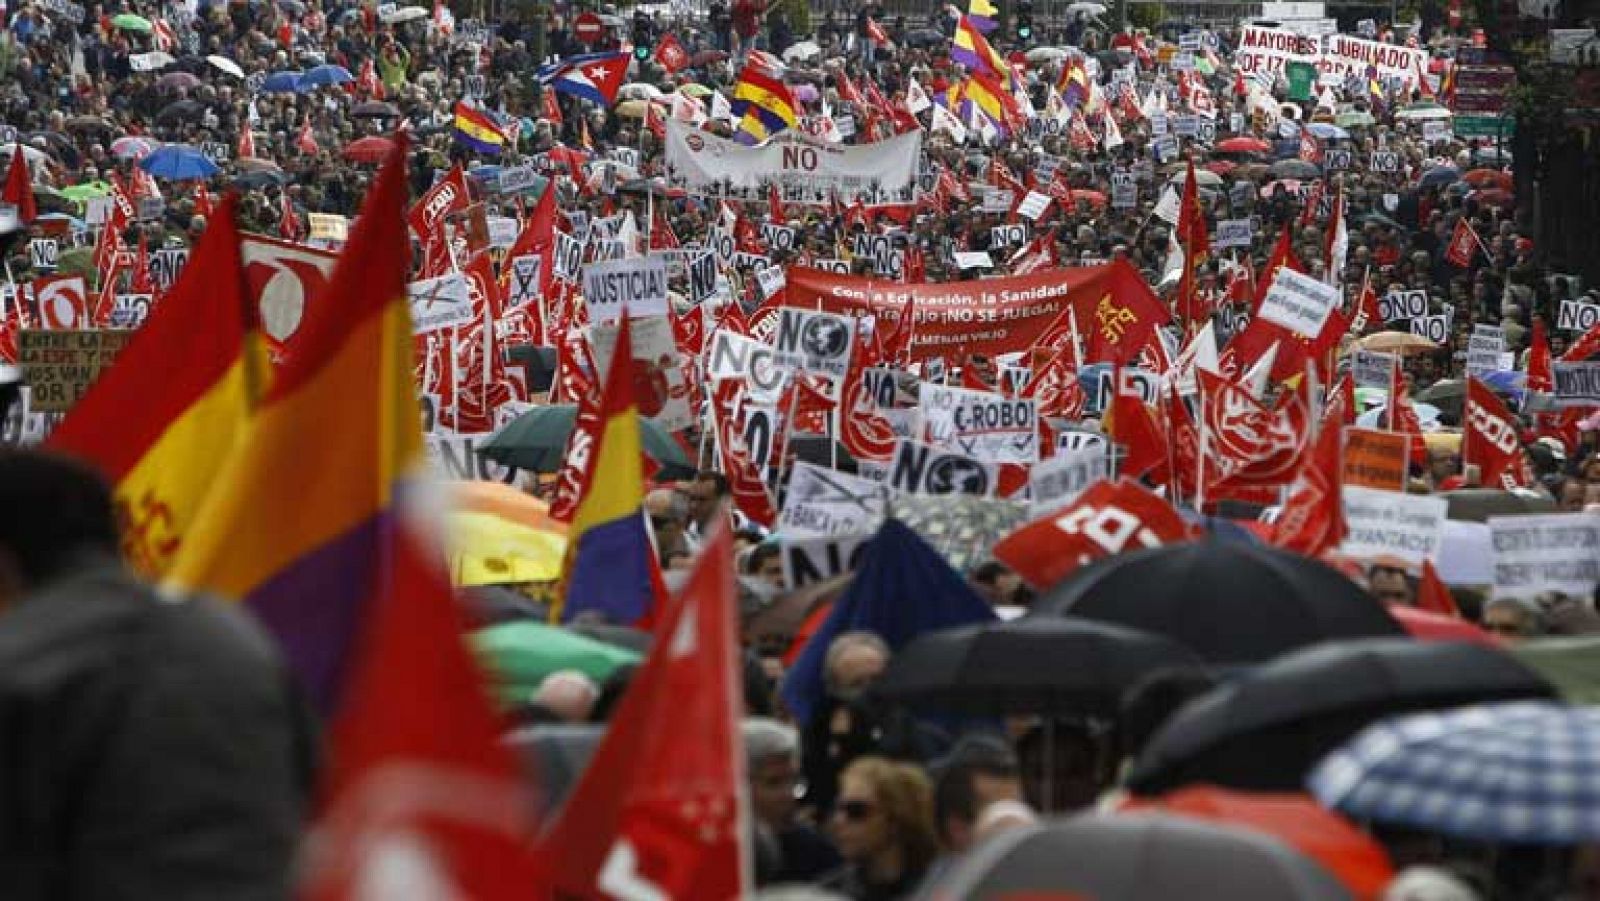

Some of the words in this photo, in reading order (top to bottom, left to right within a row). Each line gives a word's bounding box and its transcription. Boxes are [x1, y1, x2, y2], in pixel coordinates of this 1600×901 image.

[1244, 29, 1318, 55] MAYORES
[782, 148, 818, 172] NO
[764, 225, 794, 251] NO
[993, 227, 1025, 249] NO
[692, 253, 717, 303] NO
[886, 288, 978, 305] Edcación,
[982, 292, 997, 305] la
[1001, 282, 1068, 304] Sanidad
[1392, 291, 1429, 321] NO
[1558, 304, 1592, 331] NO
[1412, 318, 1448, 345] NO
